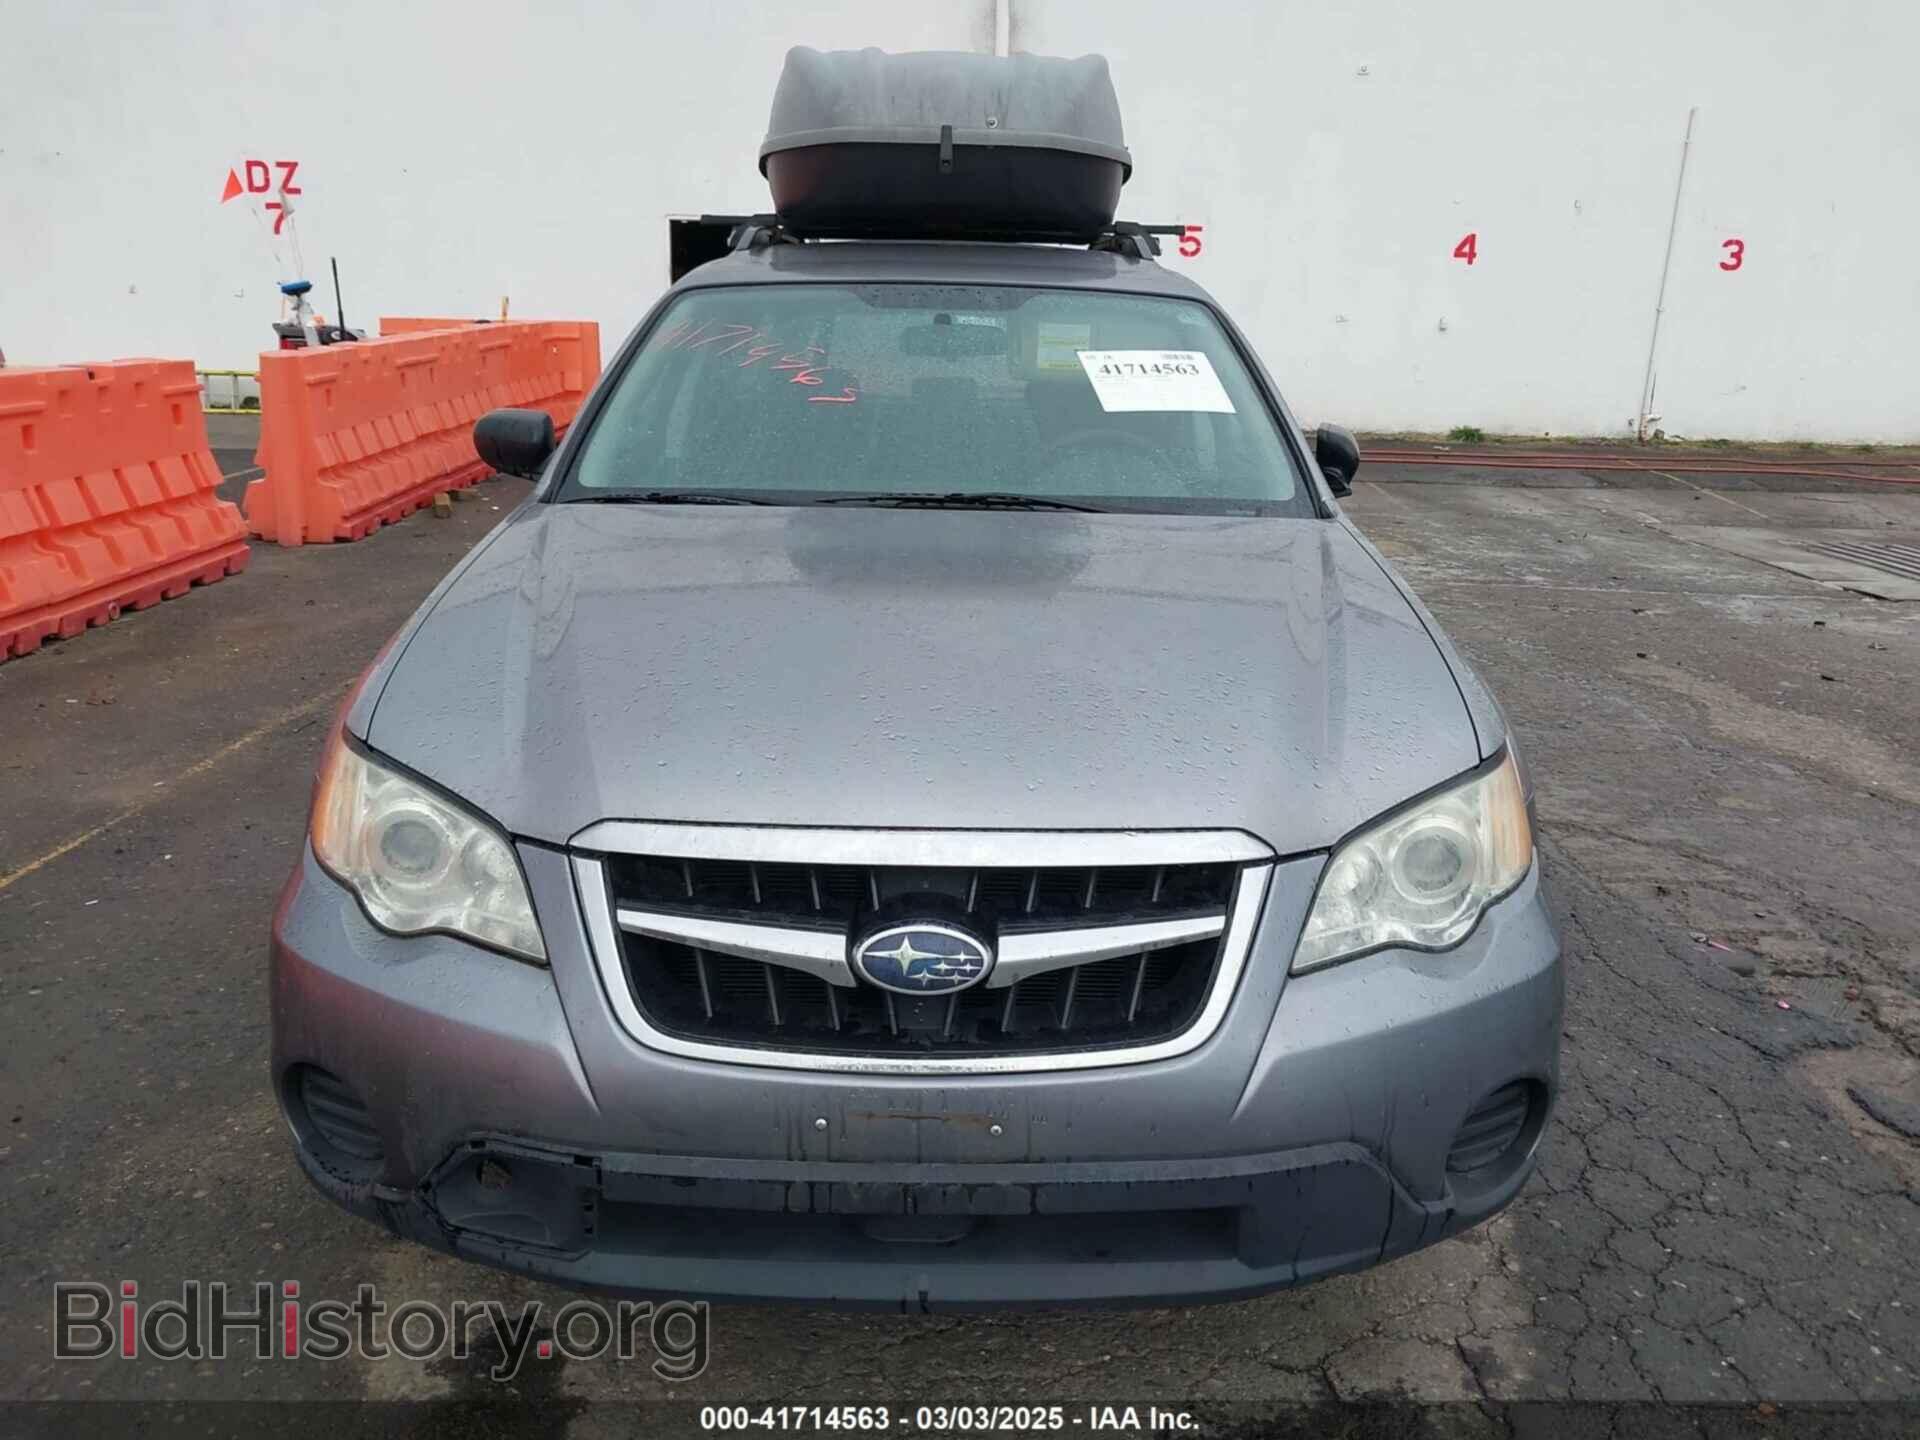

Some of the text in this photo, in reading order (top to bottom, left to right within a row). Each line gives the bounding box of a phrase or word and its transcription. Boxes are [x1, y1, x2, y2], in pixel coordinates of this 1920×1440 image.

[265, 202, 287, 235] 7
[1179, 225, 1203, 257] 5
[1453, 233, 1477, 265] 4
[1719, 239, 1745, 271] 3
[1099, 362, 1200, 376] 41714563
